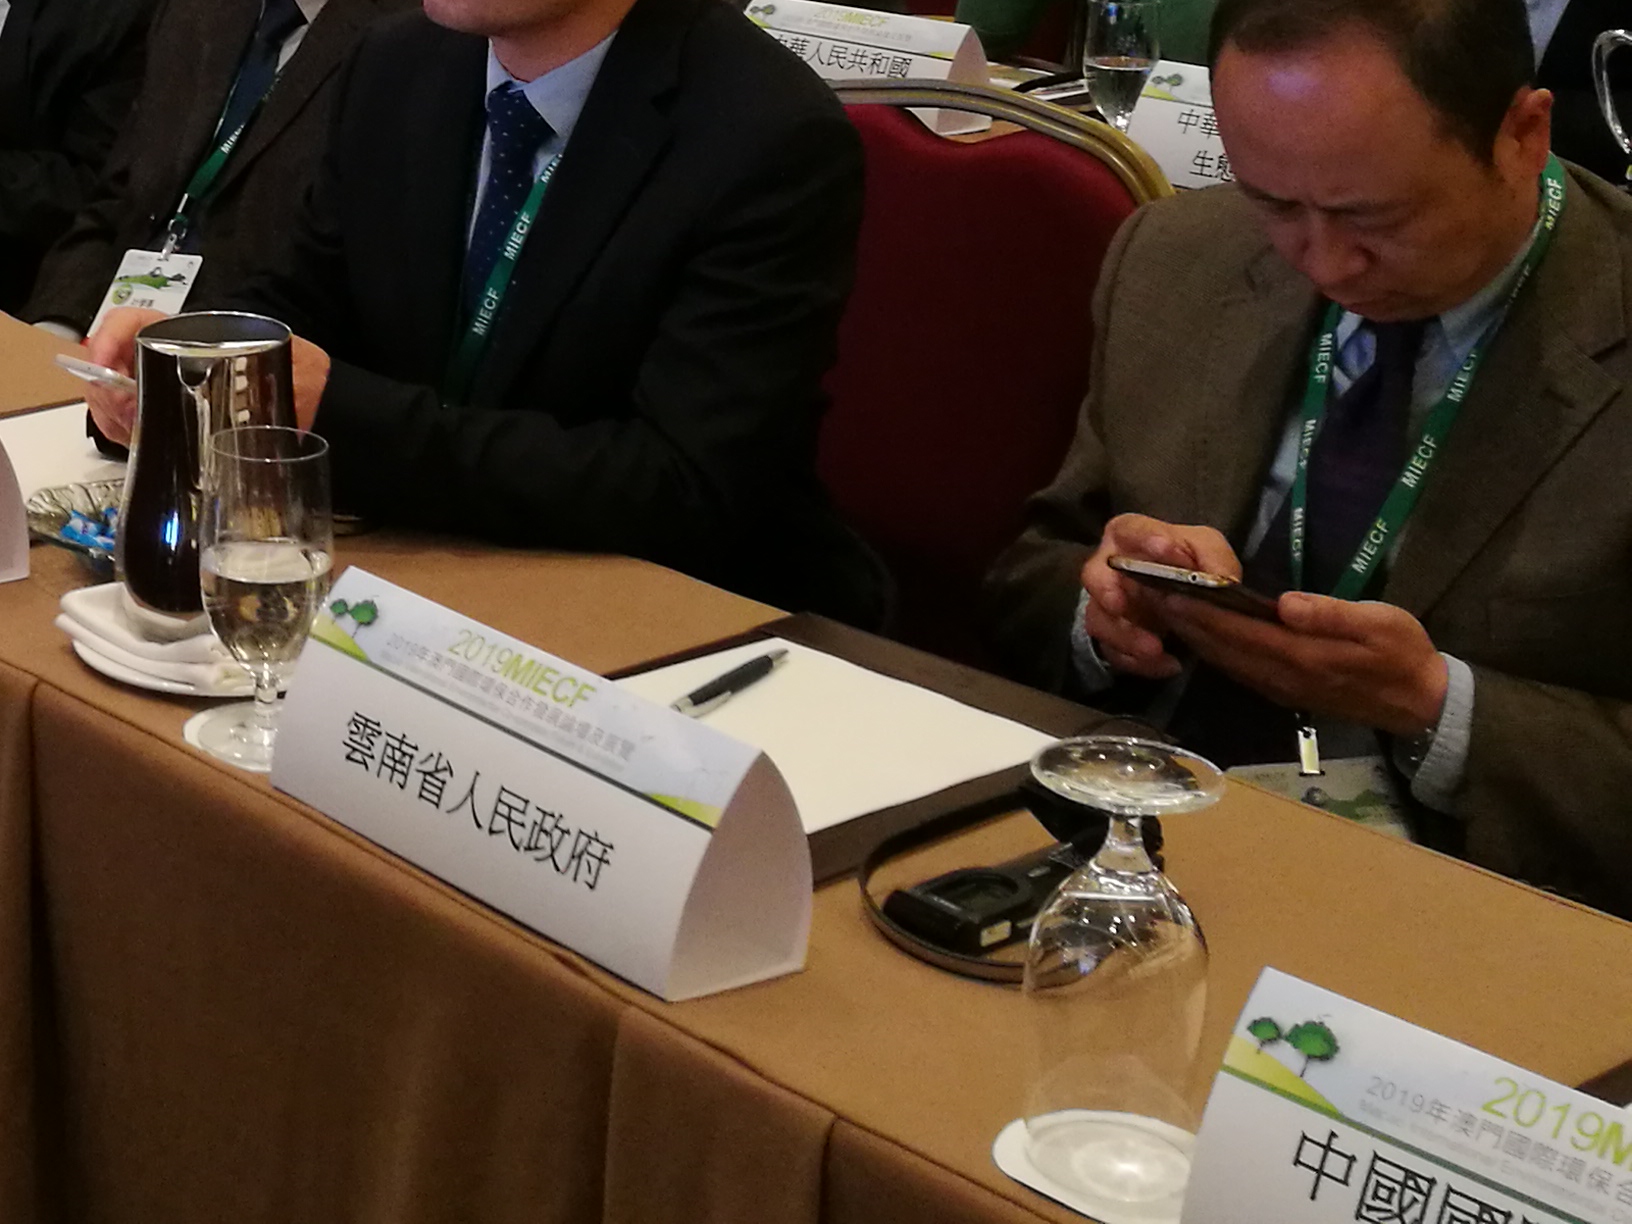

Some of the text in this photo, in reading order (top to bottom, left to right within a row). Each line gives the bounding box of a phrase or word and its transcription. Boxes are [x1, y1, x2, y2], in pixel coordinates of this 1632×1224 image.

[1545, 177, 1563, 230] MIECF
[503, 212, 532, 261] MIECF
[472, 287, 499, 336] MIECF
[1313, 333, 1333, 384] MIECF
[1401, 434, 1437, 488] MIECF
[1352, 518, 1390, 573] MIECF
[448, 628, 597, 707] 2019MIECF
[341, 711, 615, 891] 雲南省人民政府
